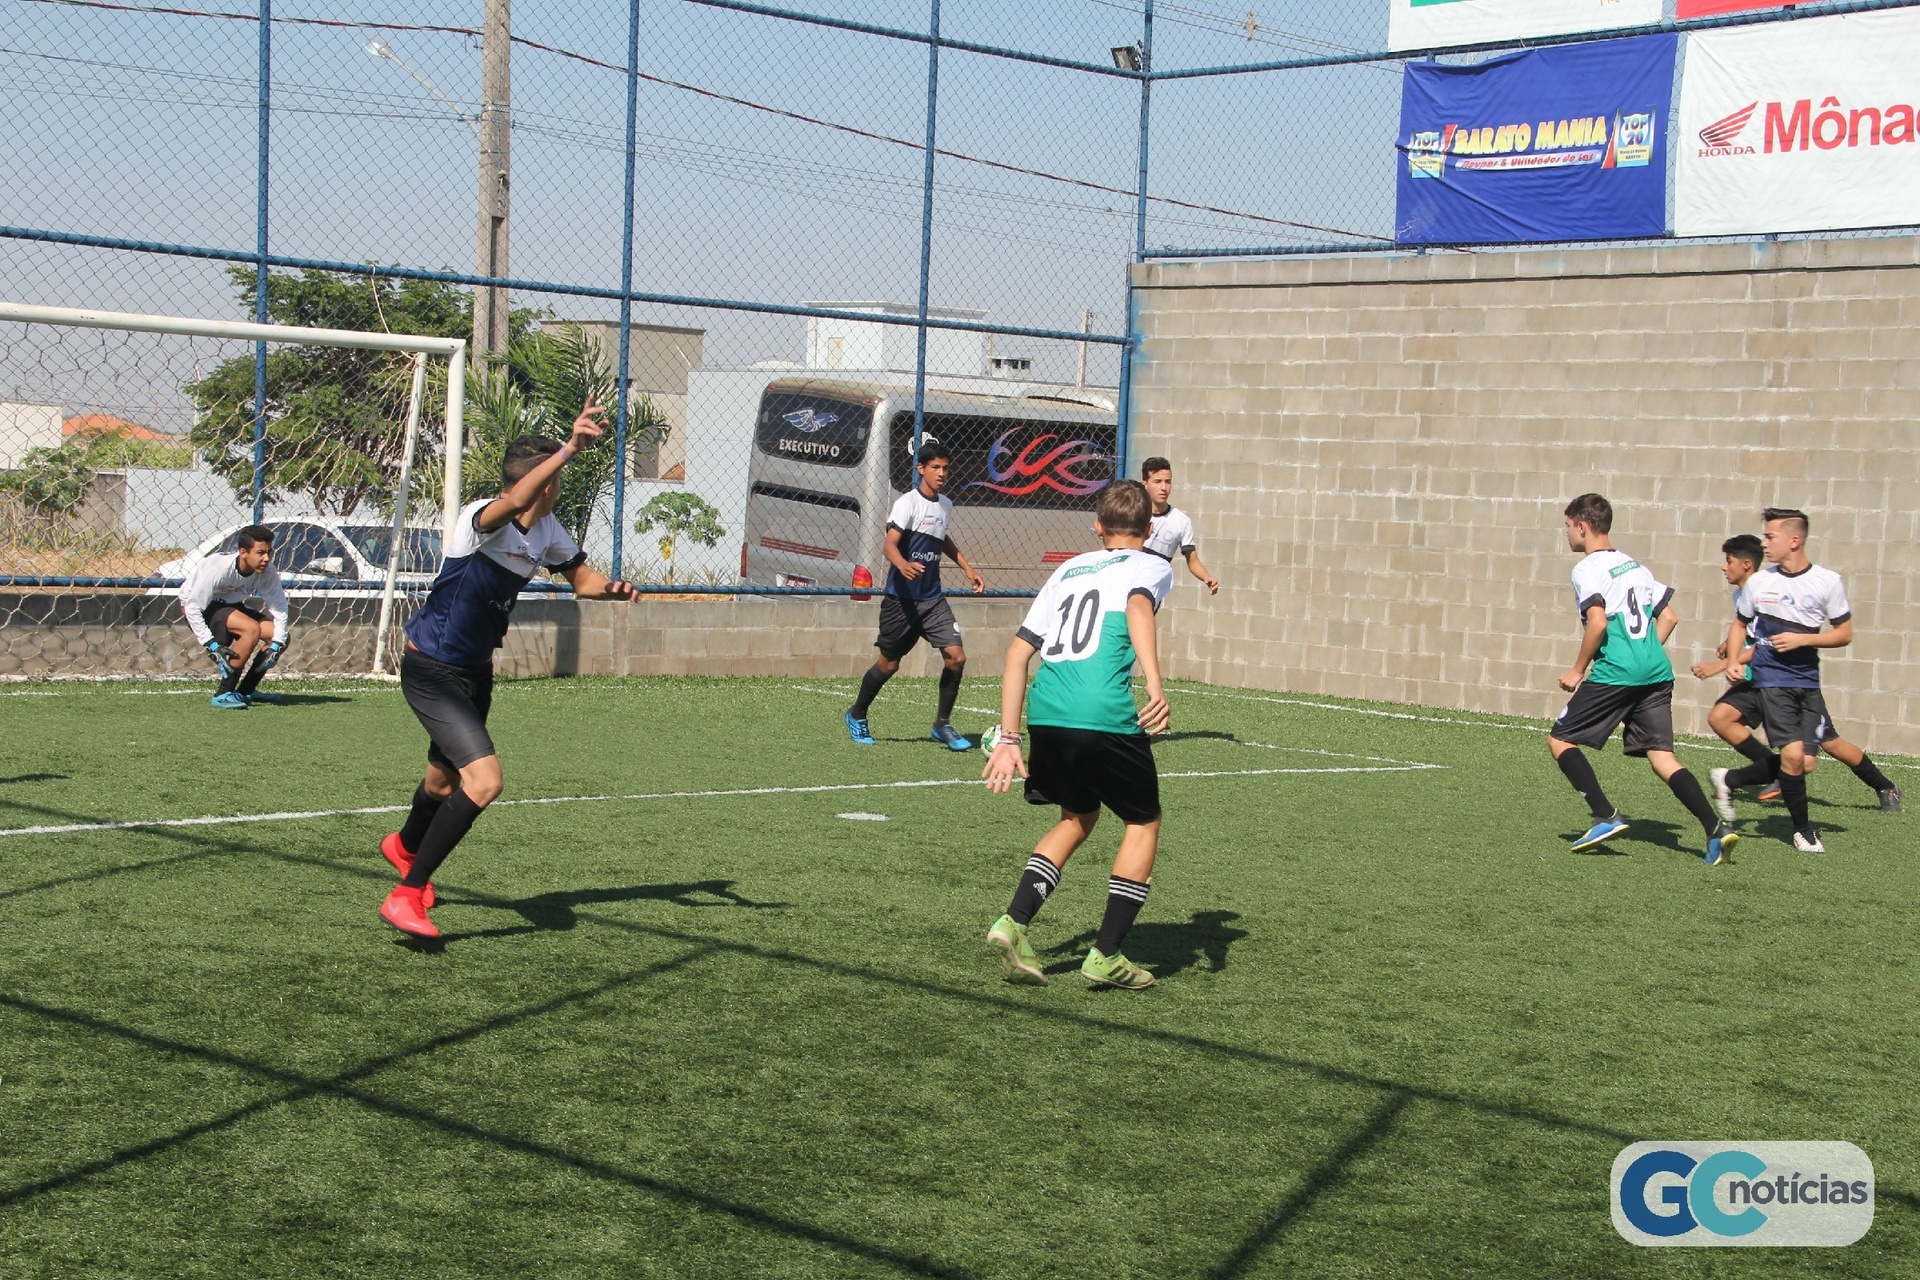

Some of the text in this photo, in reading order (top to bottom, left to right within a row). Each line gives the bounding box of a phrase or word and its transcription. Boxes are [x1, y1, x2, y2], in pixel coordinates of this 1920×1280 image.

[1622, 114, 1650, 131] TOP
[1763, 95, 1920, 154] Môna
[1415, 131, 1440, 149] TOP
[1453, 116, 1607, 154] BARATO MANIA
[1625, 130, 1645, 146] 20
[1697, 145, 1757, 158] HONDA
[779, 438, 840, 457] EXECUTIVO
[1626, 586, 1643, 634] 9
[1046, 589, 1100, 656] 10
